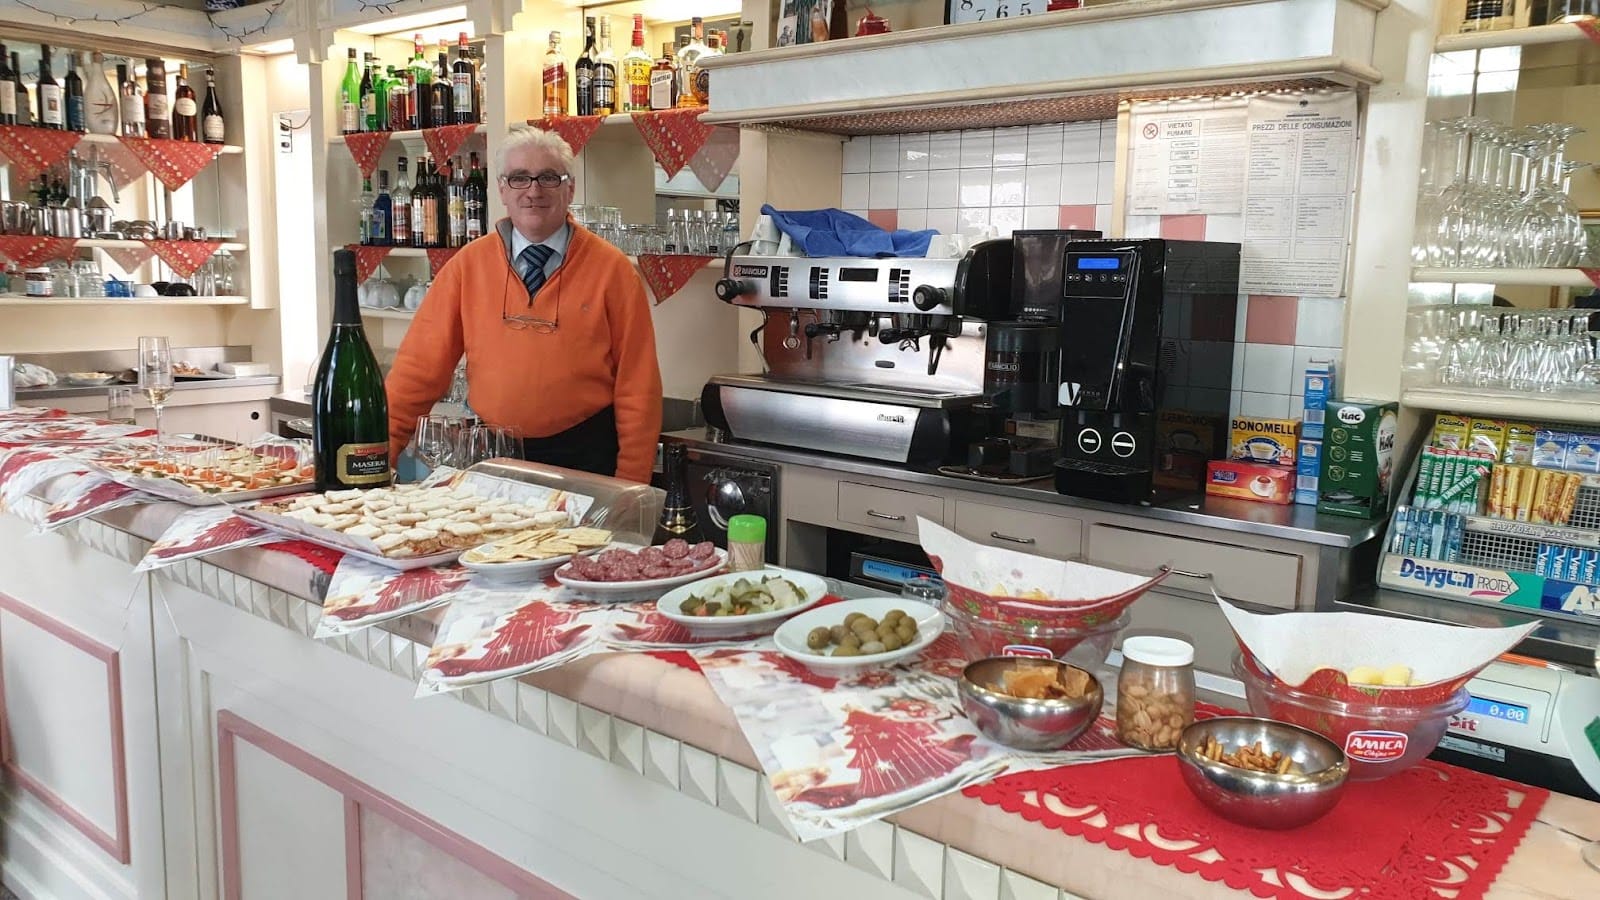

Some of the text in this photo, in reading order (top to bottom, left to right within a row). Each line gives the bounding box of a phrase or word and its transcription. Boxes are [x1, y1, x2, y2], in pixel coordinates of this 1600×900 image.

[976, 9, 986, 21] 7
[996, 5, 1008, 18] 6
[1020, 3, 1032, 15] 5
[1167, 121, 1193, 129] VIETATO
[1252, 120, 1353, 131] PREZZI DELLE CONSUMAZIONI
[1166, 129, 1193, 137] FUMARE
[1232, 419, 1296, 435] BONOMELLI
[1438, 417, 1465, 427] Ricola
[1473, 422, 1502, 432] Ricola
[1478, 576, 1514, 593] PROTEX
[1350, 737, 1403, 750] AMICA
